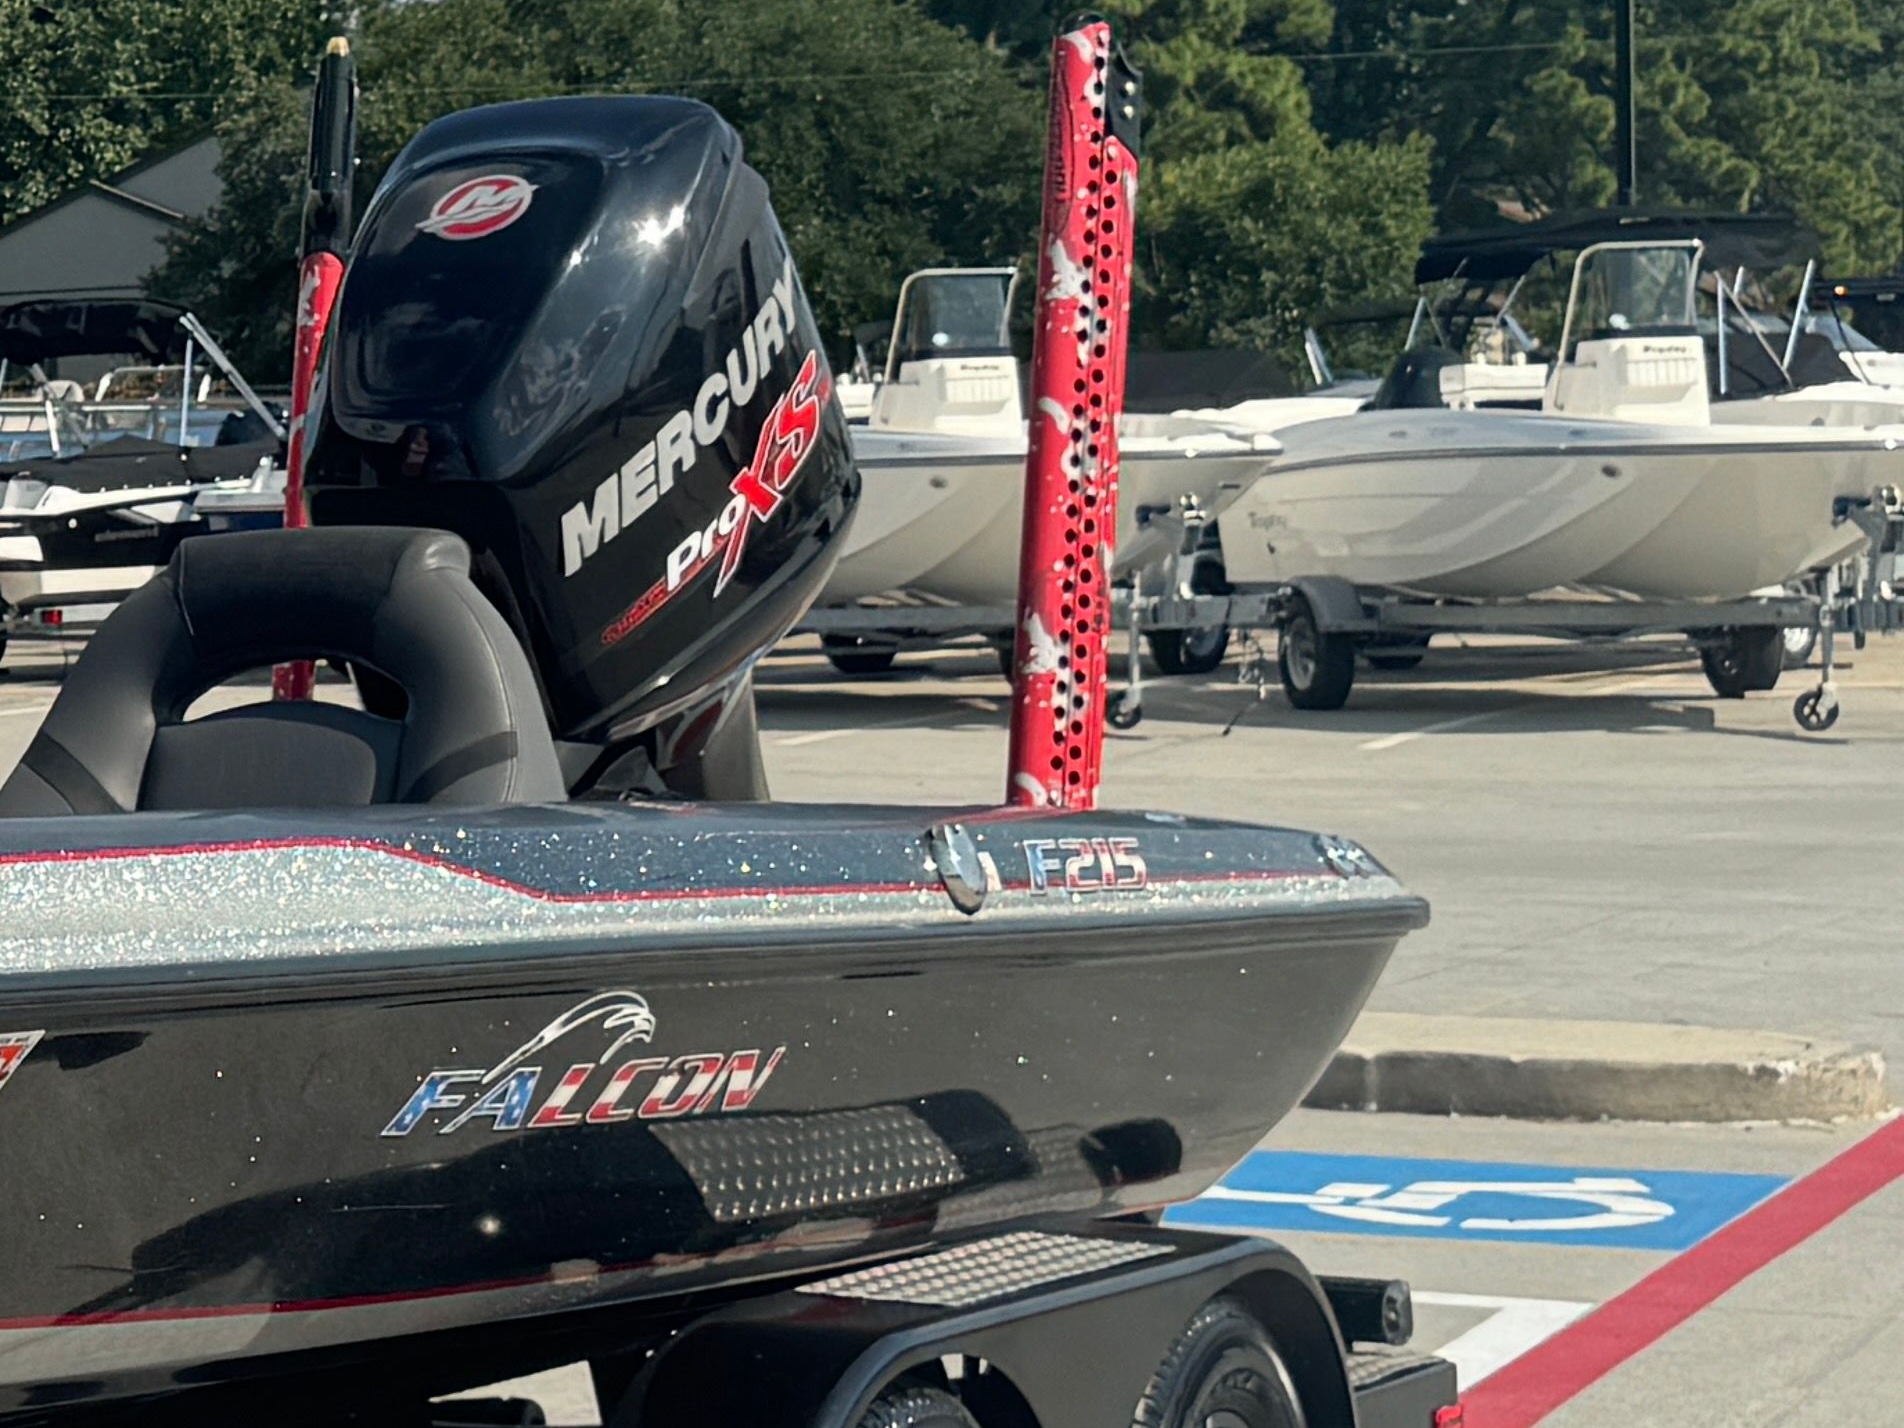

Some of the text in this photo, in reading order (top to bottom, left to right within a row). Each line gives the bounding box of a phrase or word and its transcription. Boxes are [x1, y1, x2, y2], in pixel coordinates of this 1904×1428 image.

[561, 256, 797, 577] MERCURY
[1023, 836, 1147, 896] F215
[379, 1045, 787, 1137] FALCON
